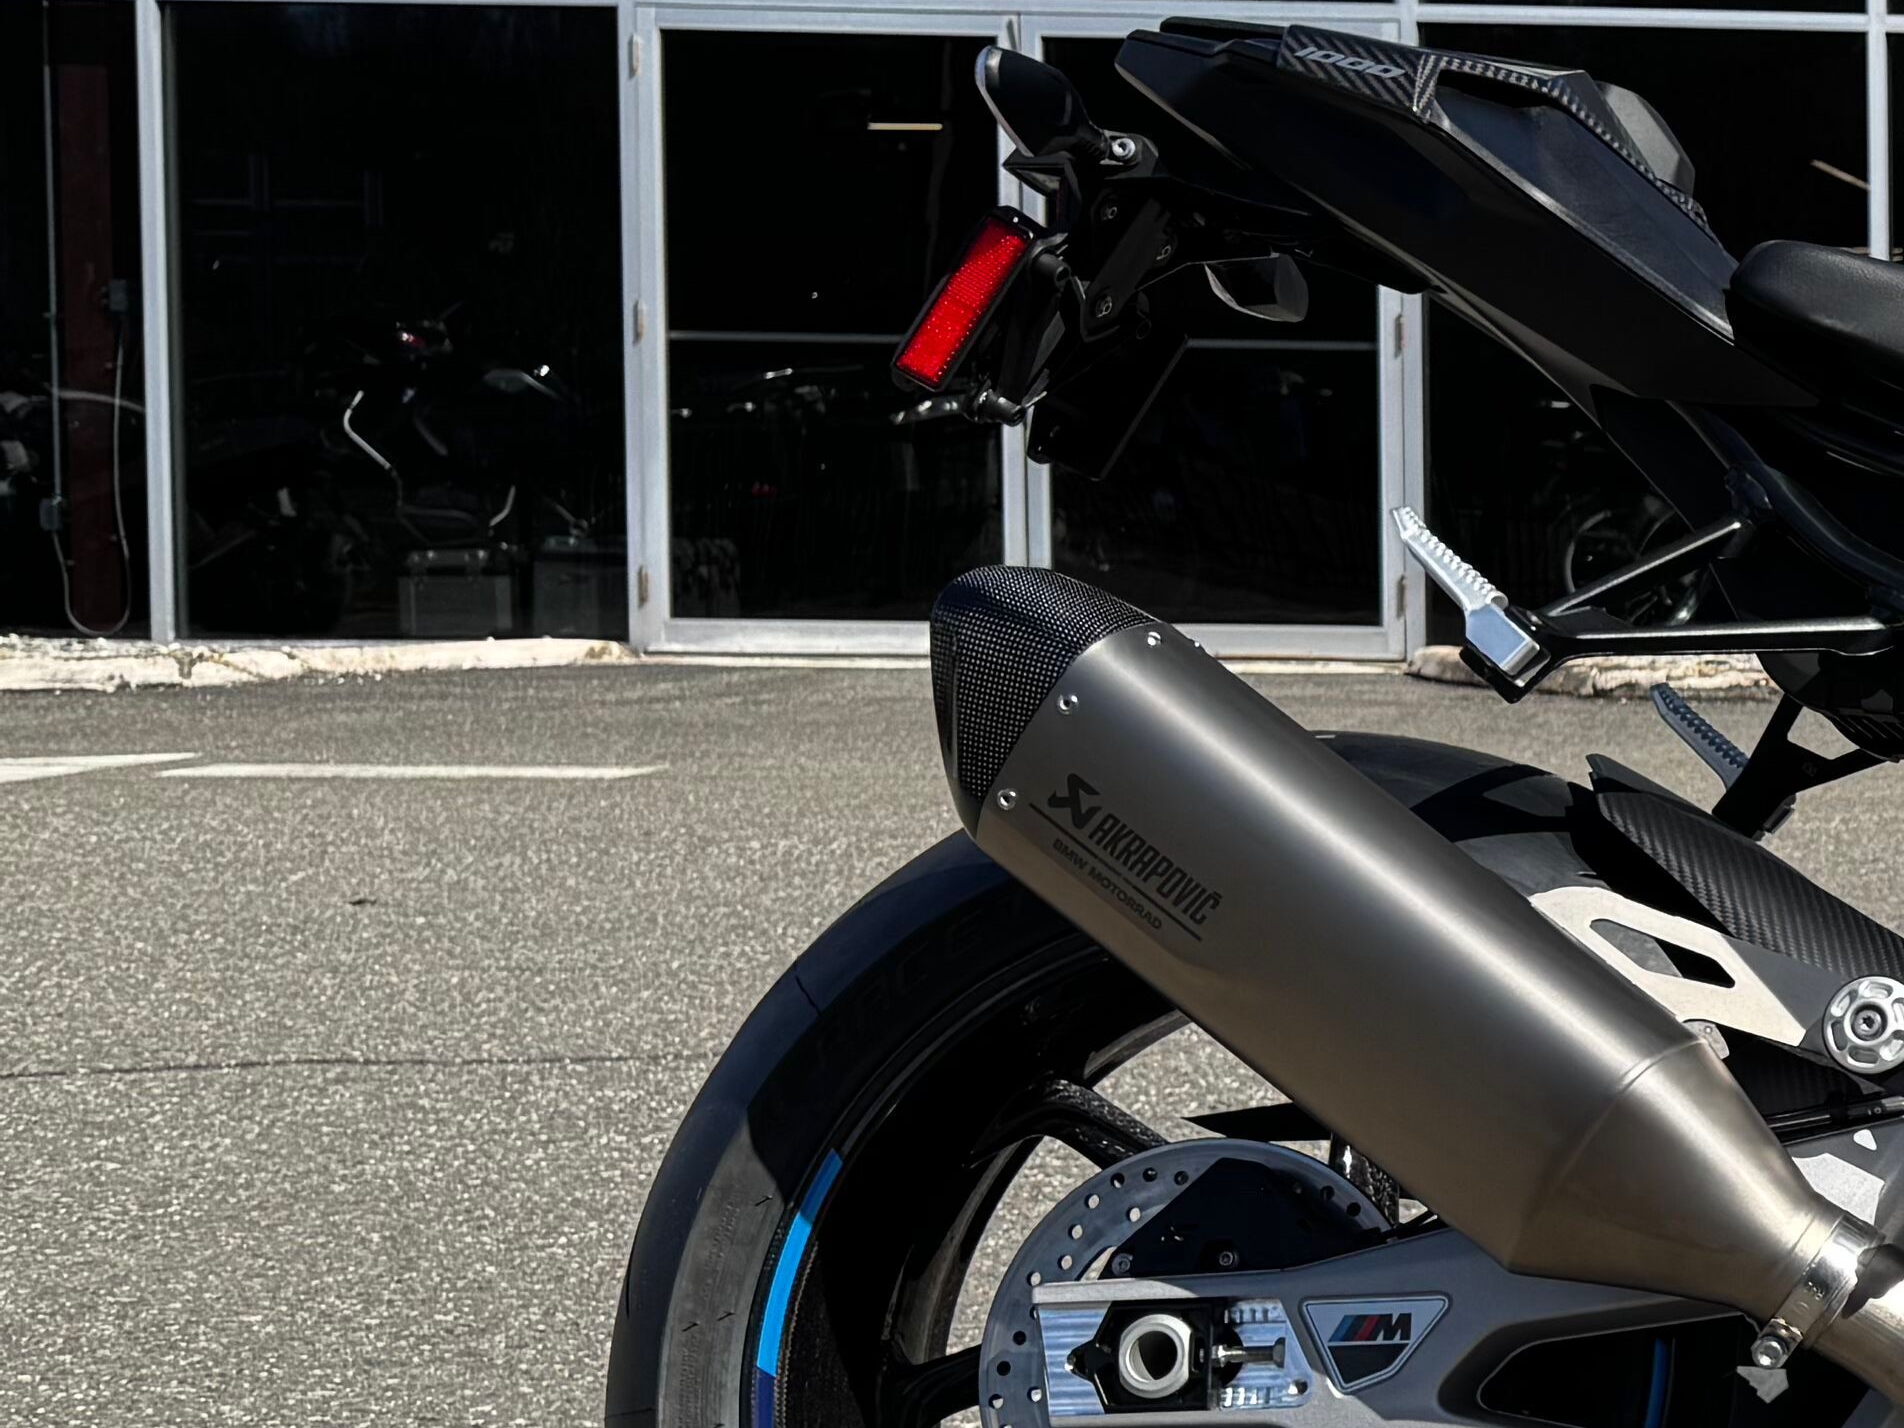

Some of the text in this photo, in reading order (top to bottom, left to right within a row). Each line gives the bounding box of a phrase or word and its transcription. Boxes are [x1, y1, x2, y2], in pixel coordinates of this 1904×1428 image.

[1293, 46, 1406, 79] 1000
[1052, 837, 1163, 931] BMW MOTORRAD
